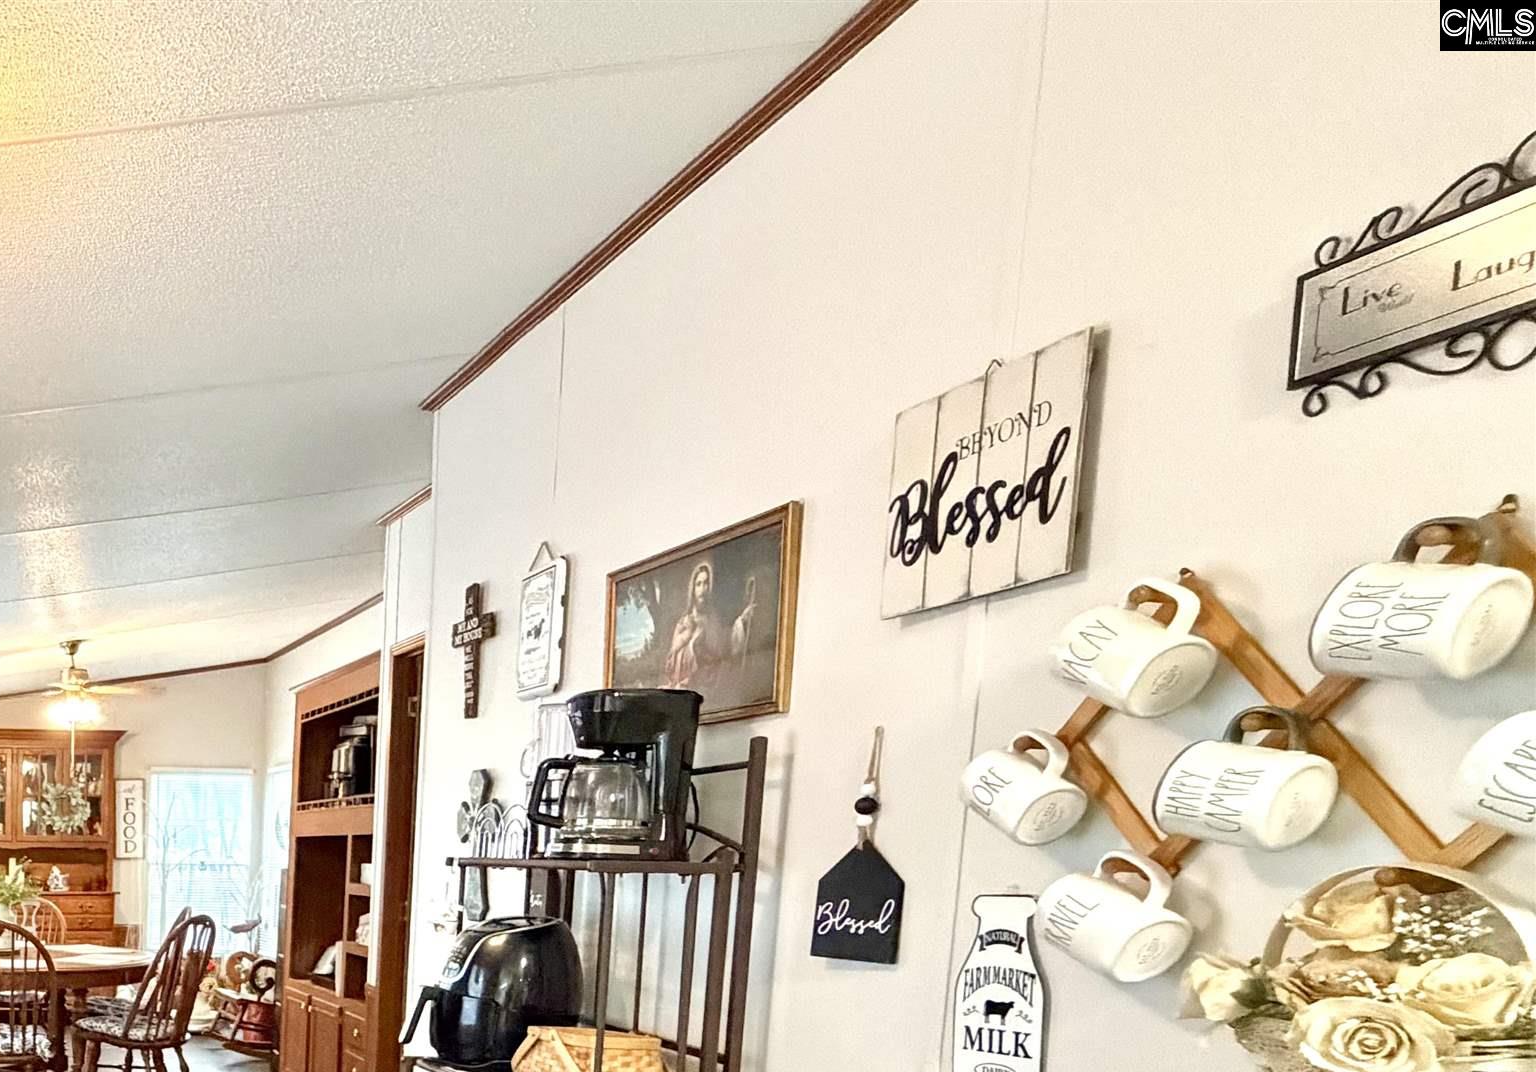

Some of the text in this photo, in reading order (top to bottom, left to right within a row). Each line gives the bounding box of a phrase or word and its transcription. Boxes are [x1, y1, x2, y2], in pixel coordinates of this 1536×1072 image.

[1341, 282, 1404, 316] Live
[955, 400, 1053, 461] BEYOND
[888, 426, 1072, 567] Blessed
[1327, 580, 1405, 661] EXPLORE
[1377, 592, 1450, 656] MORE
[1060, 618, 1118, 686] VACAY
[1165, 769, 1212, 819] HAPPY
[1203, 767, 1266, 834] CAMPER
[123, 797, 137, 853] FOOD
[816, 898, 896, 935] Blessed
[1044, 894, 1101, 947] RAVEL
[962, 965, 1037, 1008] FARM MARKET
[962, 1025, 1033, 1060] MILK
